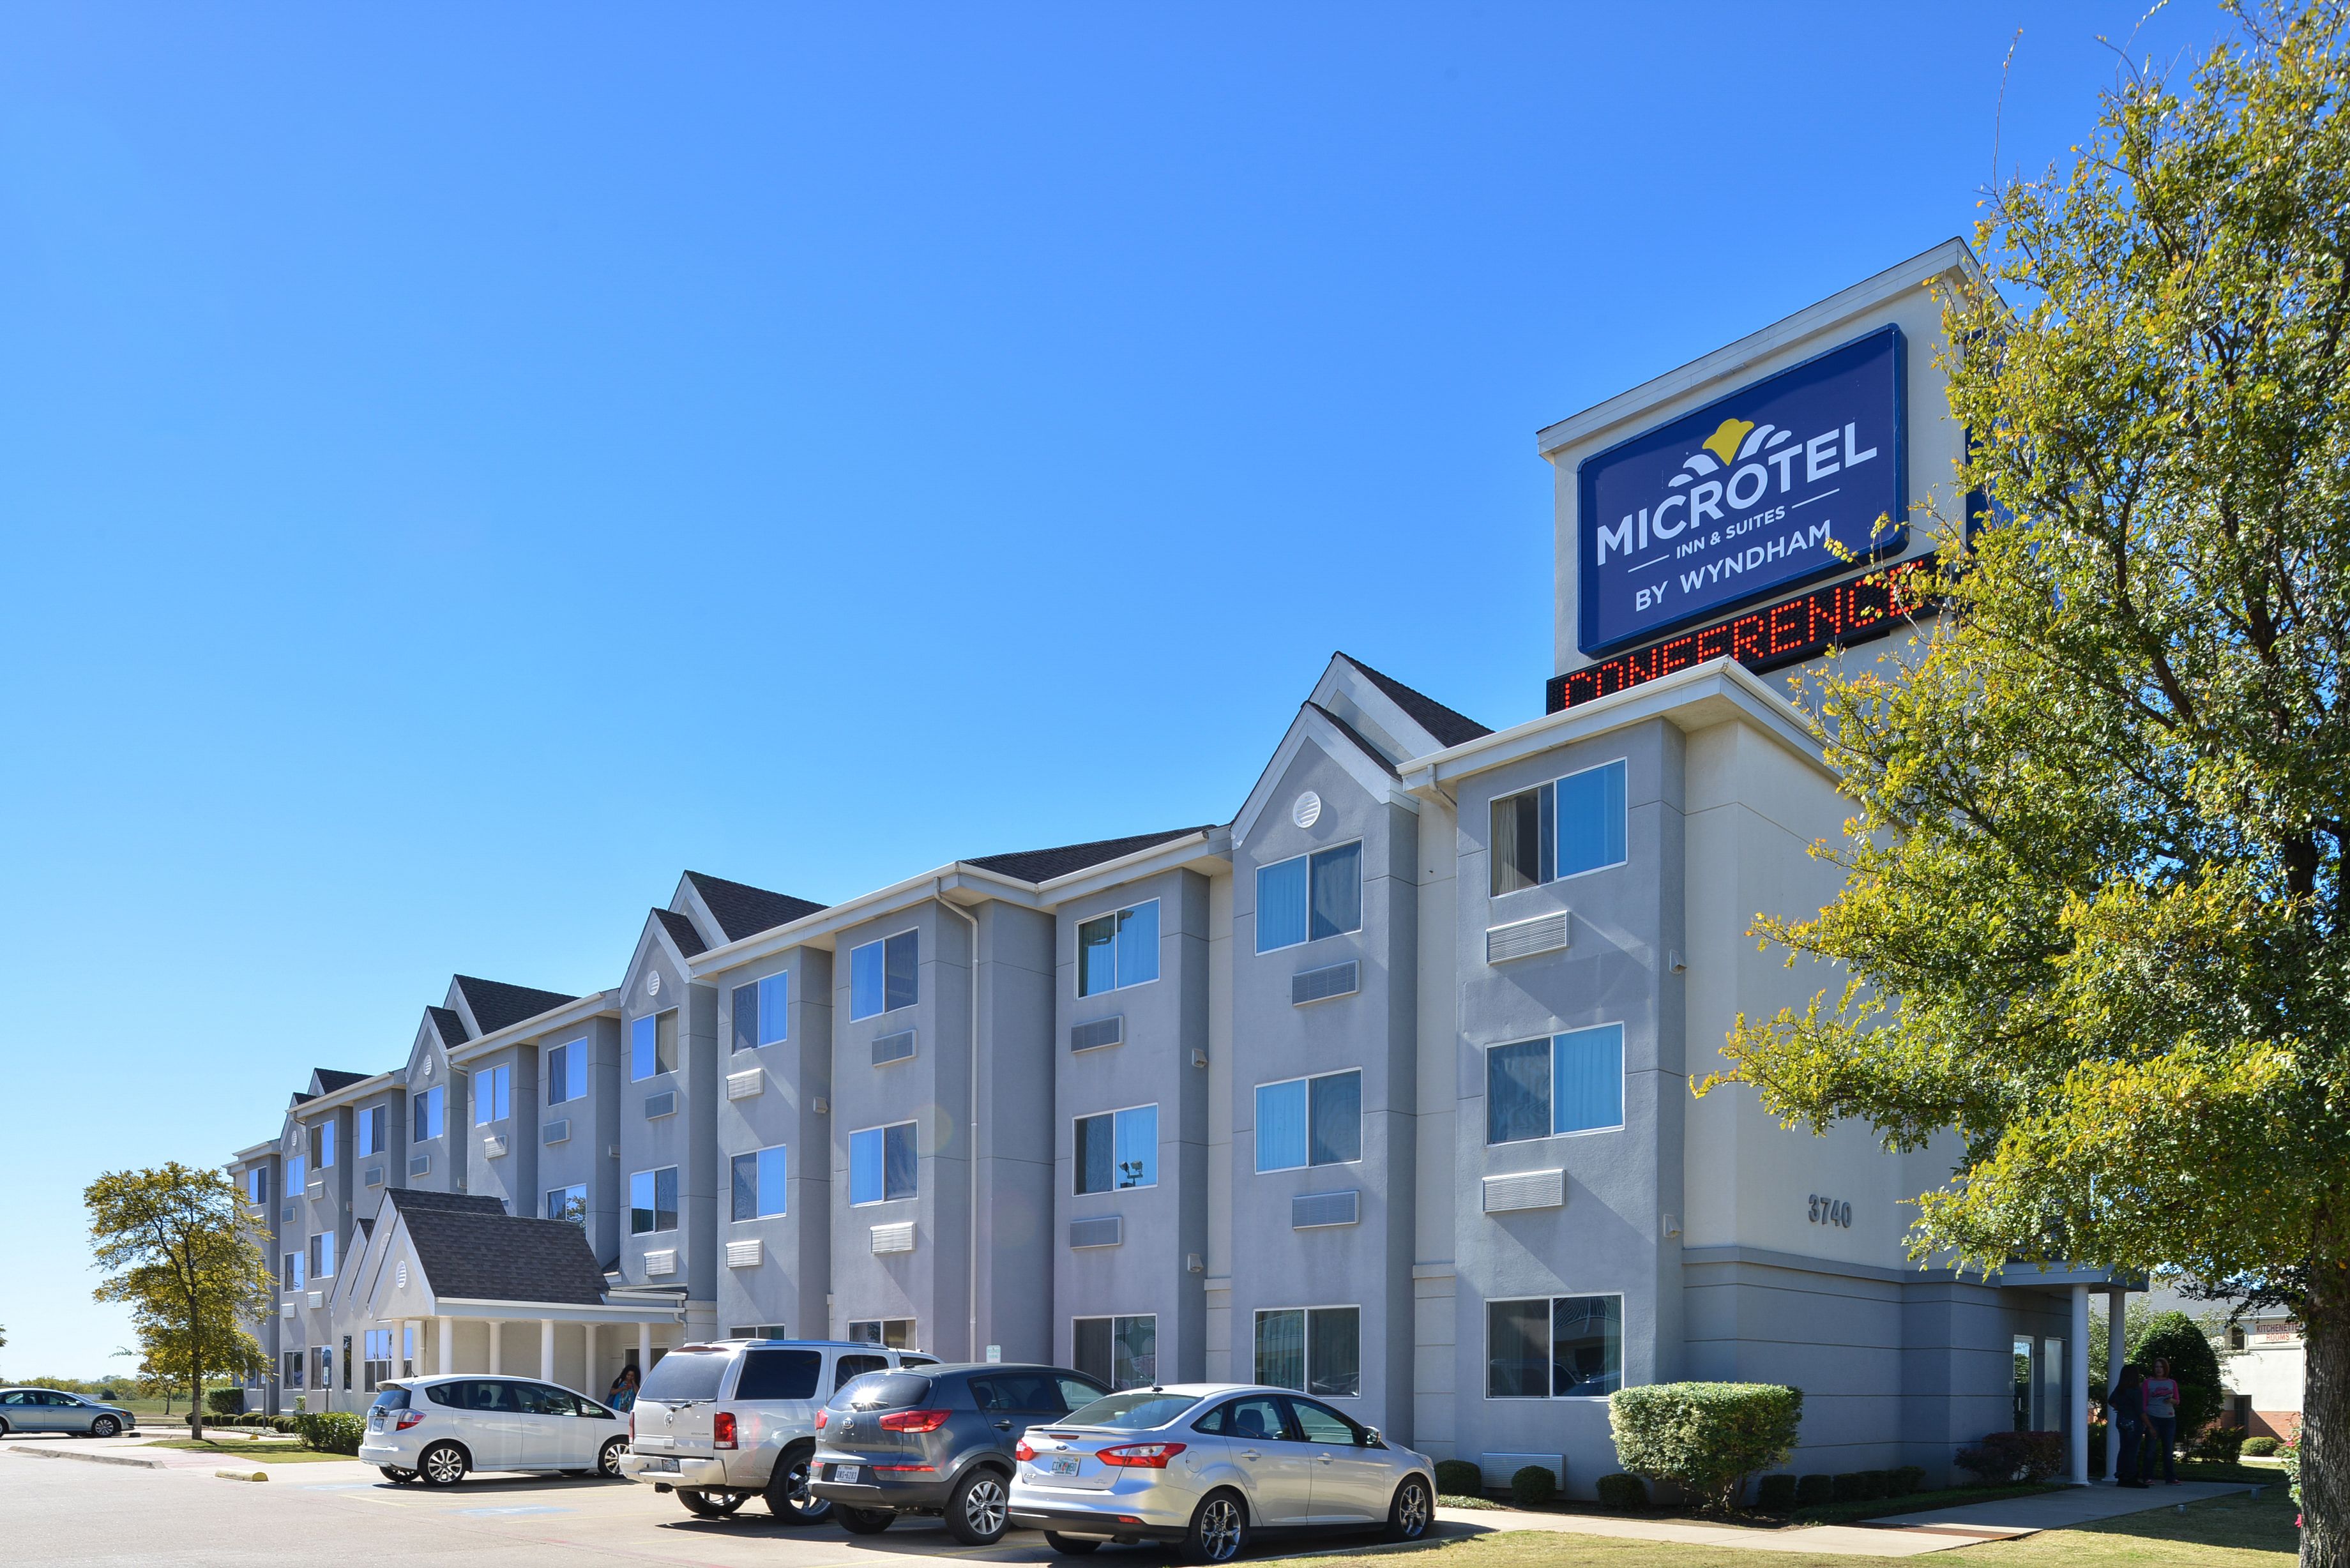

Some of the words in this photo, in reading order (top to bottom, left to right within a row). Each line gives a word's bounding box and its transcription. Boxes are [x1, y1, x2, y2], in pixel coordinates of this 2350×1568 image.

[1597, 422, 1877, 566] MICROTEL
[1676, 537, 1705, 559] INN
[1709, 531, 1721, 545] &
[1725, 506, 1785, 539] SUITES
[1635, 580, 1669, 612] BY
[1679, 519, 1830, 594] WYNDHAM
[1808, 1194, 1852, 1228] 3740
[2256, 1322, 2299, 1333] KITCHENETTE
[2266, 1332, 2290, 1341] ROOMS
